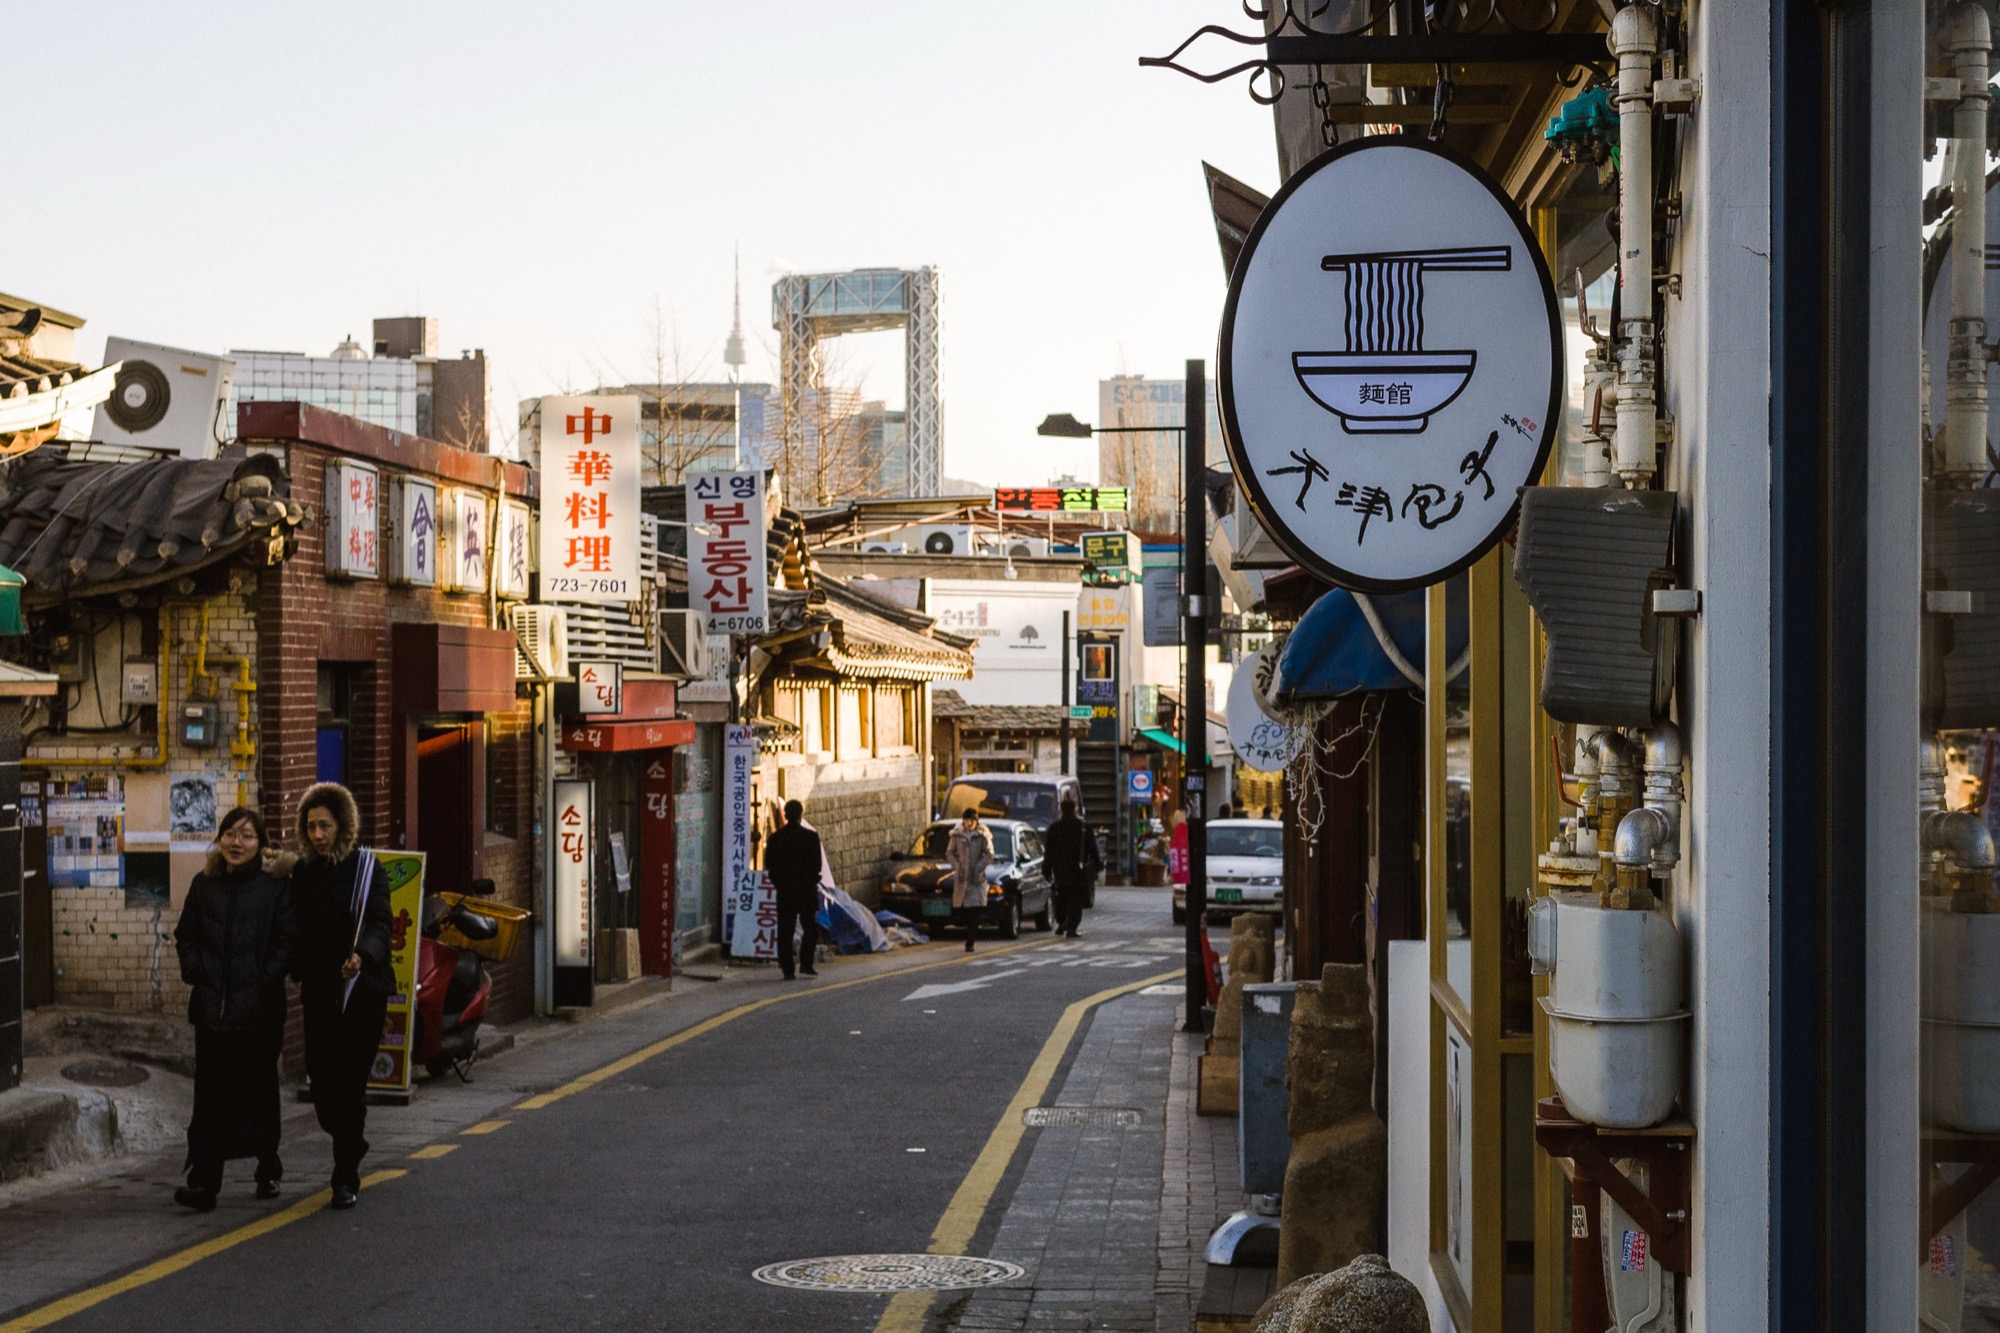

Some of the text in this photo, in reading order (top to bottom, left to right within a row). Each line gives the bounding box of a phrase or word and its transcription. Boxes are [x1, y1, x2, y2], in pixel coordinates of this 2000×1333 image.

[1359, 381, 1413, 406] 麵館
[563, 406, 614, 572] 中華料理
[694, 475, 756, 499] 신영
[702, 503, 753, 614] 부동산
[1086, 536, 1124, 557] 문구
[549, 578, 628, 593] 723-7601
[708, 616, 764, 630] 4-6706
[740, 873, 755, 912] 신영
[753, 873, 777, 955] 부동산
